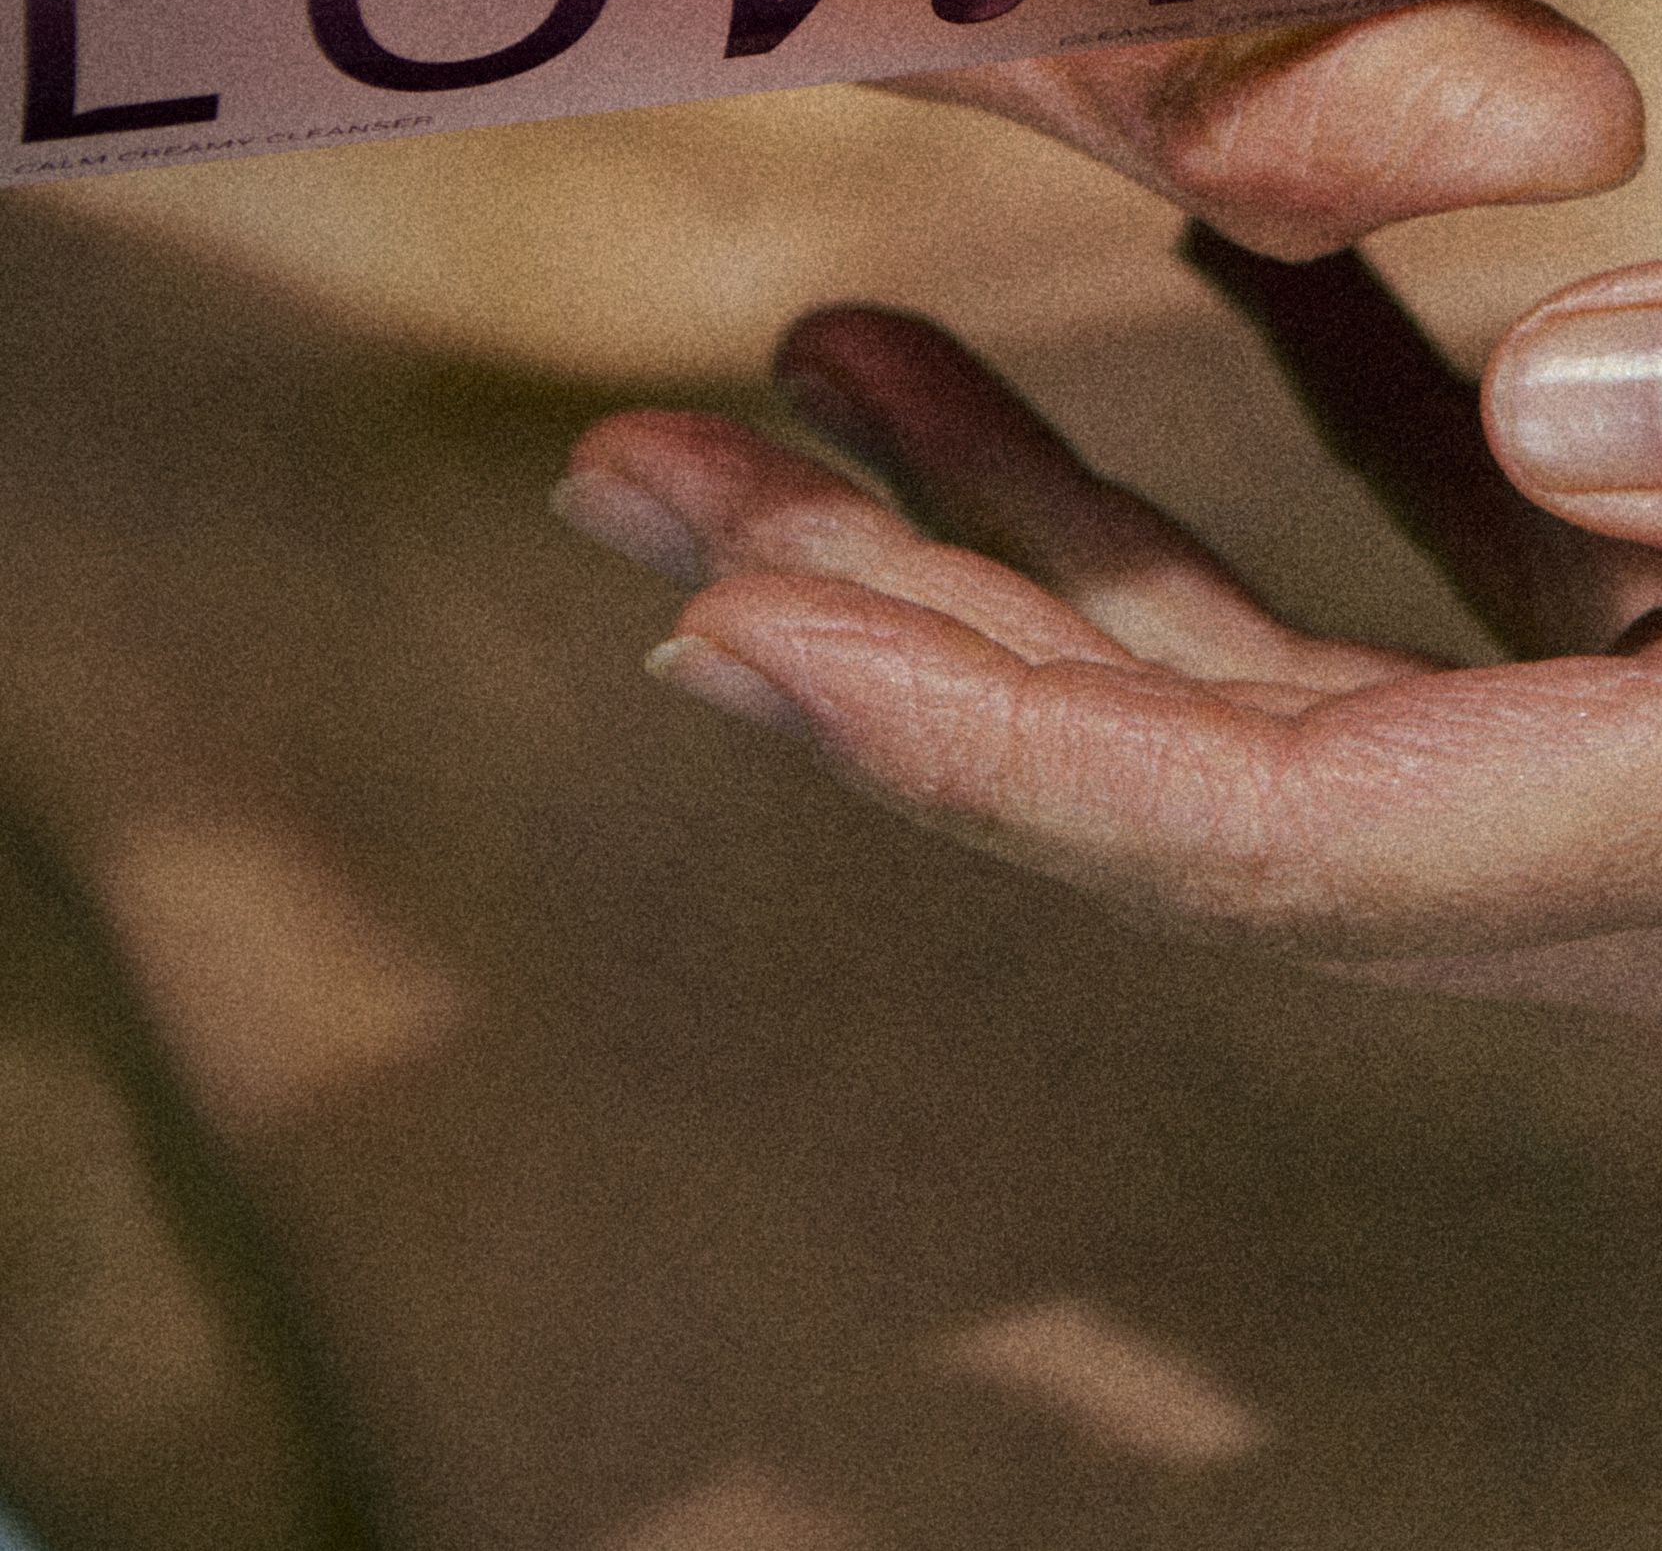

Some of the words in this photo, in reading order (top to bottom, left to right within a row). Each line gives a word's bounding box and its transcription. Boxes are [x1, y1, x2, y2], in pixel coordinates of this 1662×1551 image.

[13, 152, 107, 175] CALM
[117, 135, 255, 161] CREAMY
[265, 115, 434, 144] CLEANSER
